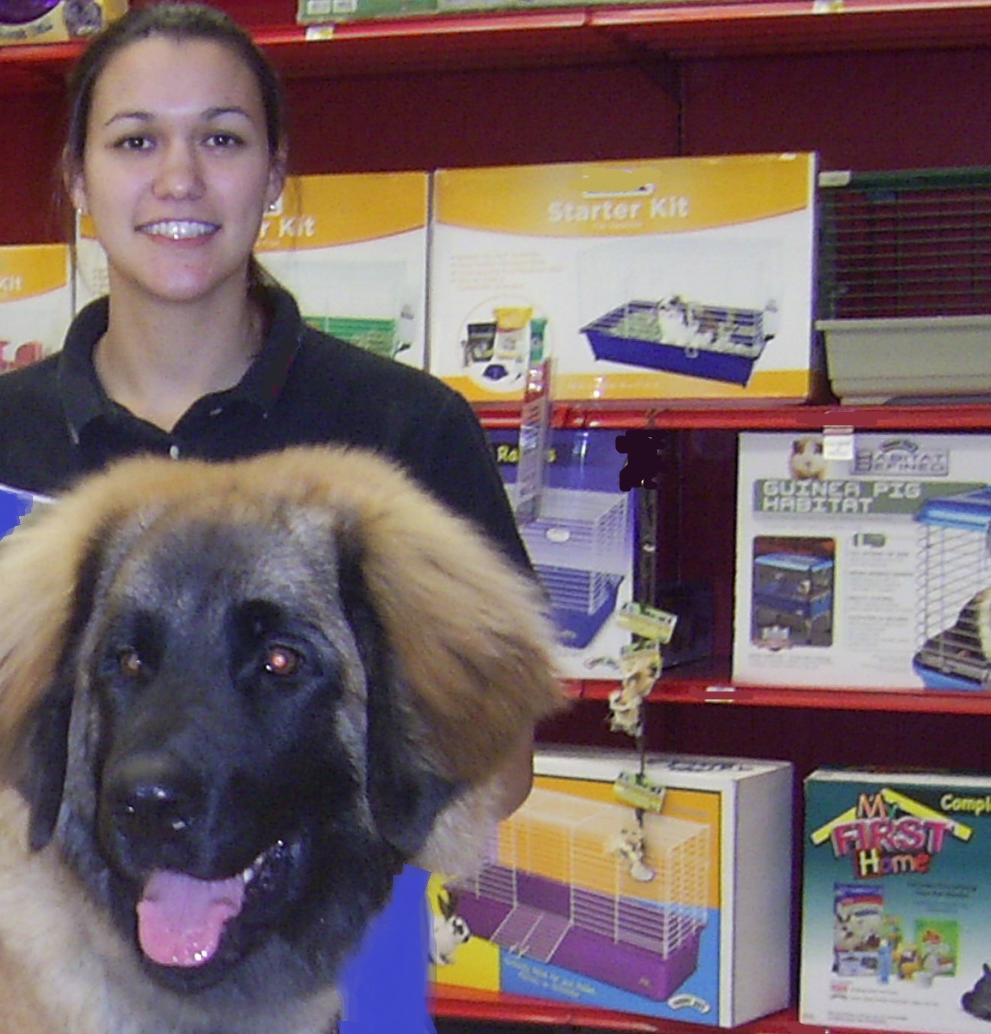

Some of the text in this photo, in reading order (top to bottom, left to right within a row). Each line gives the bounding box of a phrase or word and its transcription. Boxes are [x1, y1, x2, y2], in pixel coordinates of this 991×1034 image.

[548, 197, 690, 222] Starter Kit
[279, 216, 316, 238] Kit
[763, 481, 922, 499] GUINEA PIG
[762, 497, 874, 514] HABITAT
[857, 792, 899, 819] My
[832, 815, 949, 858] FIRST
[857, 847, 932, 877] Home
